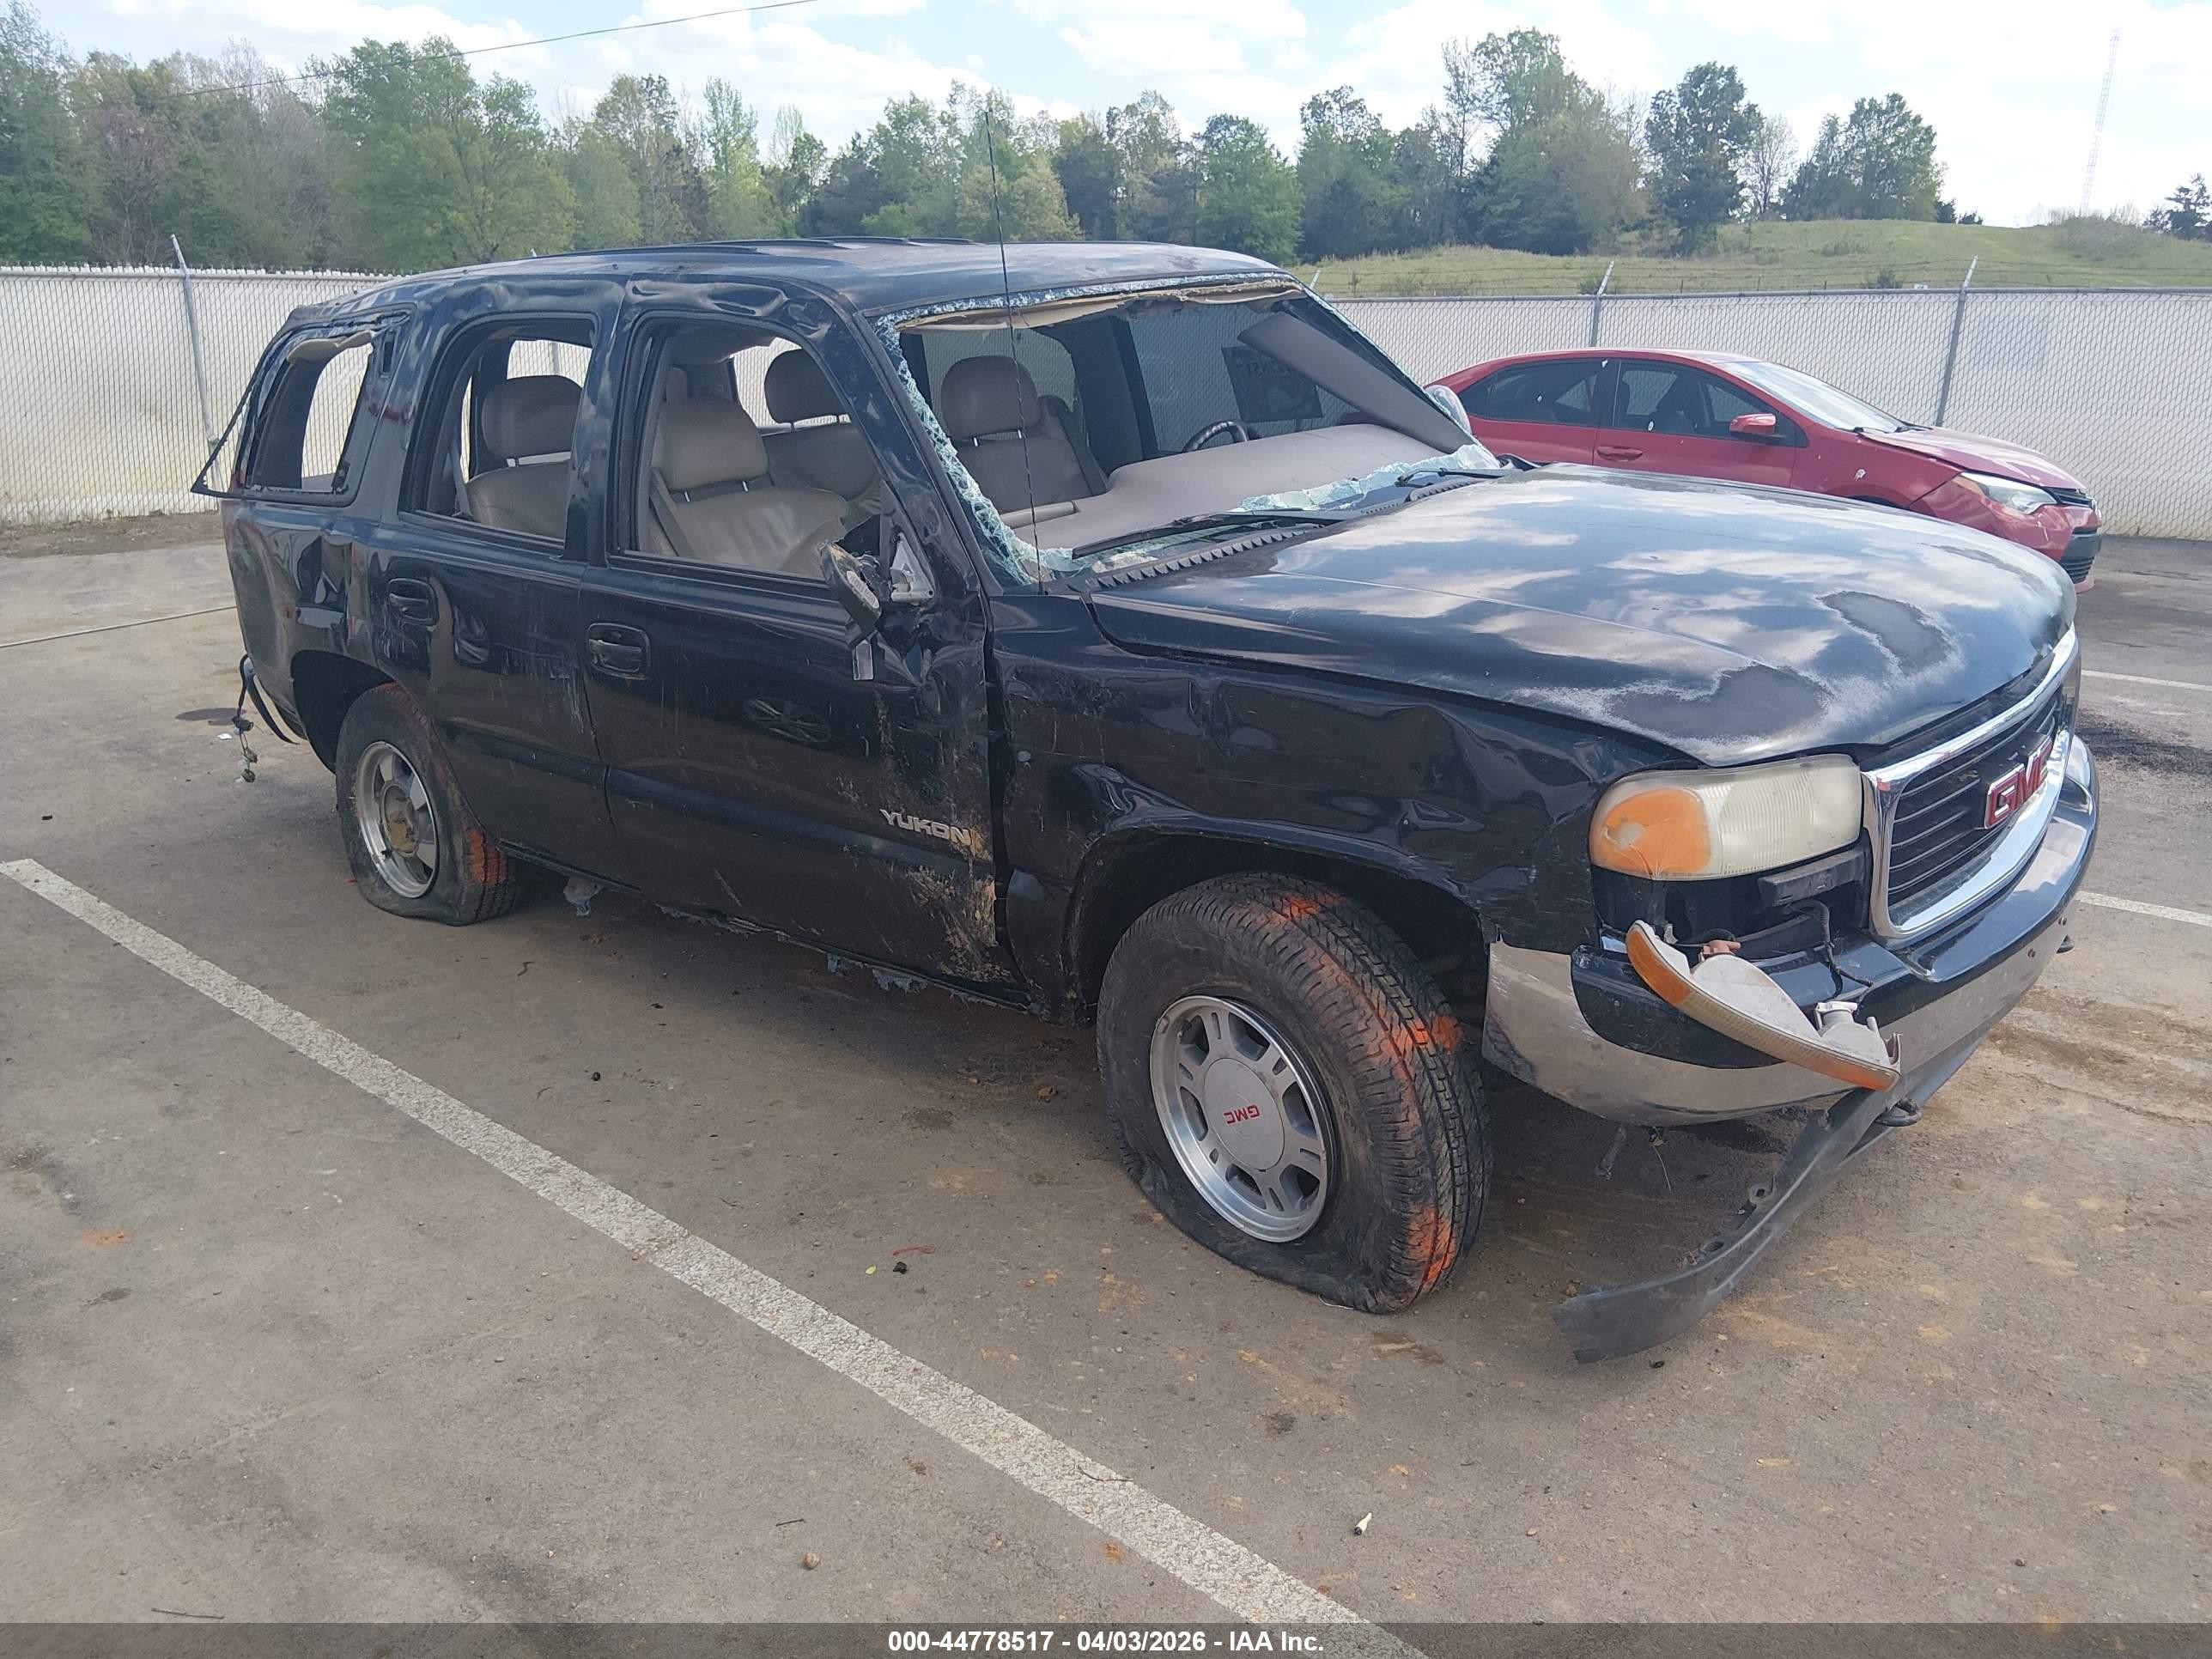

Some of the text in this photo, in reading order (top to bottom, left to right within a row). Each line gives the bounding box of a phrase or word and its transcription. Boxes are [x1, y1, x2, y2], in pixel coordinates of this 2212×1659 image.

[1984, 736, 2053, 829] GMC
[879, 809, 972, 846] YUKON
[1223, 1104, 1261, 1126] GMC
